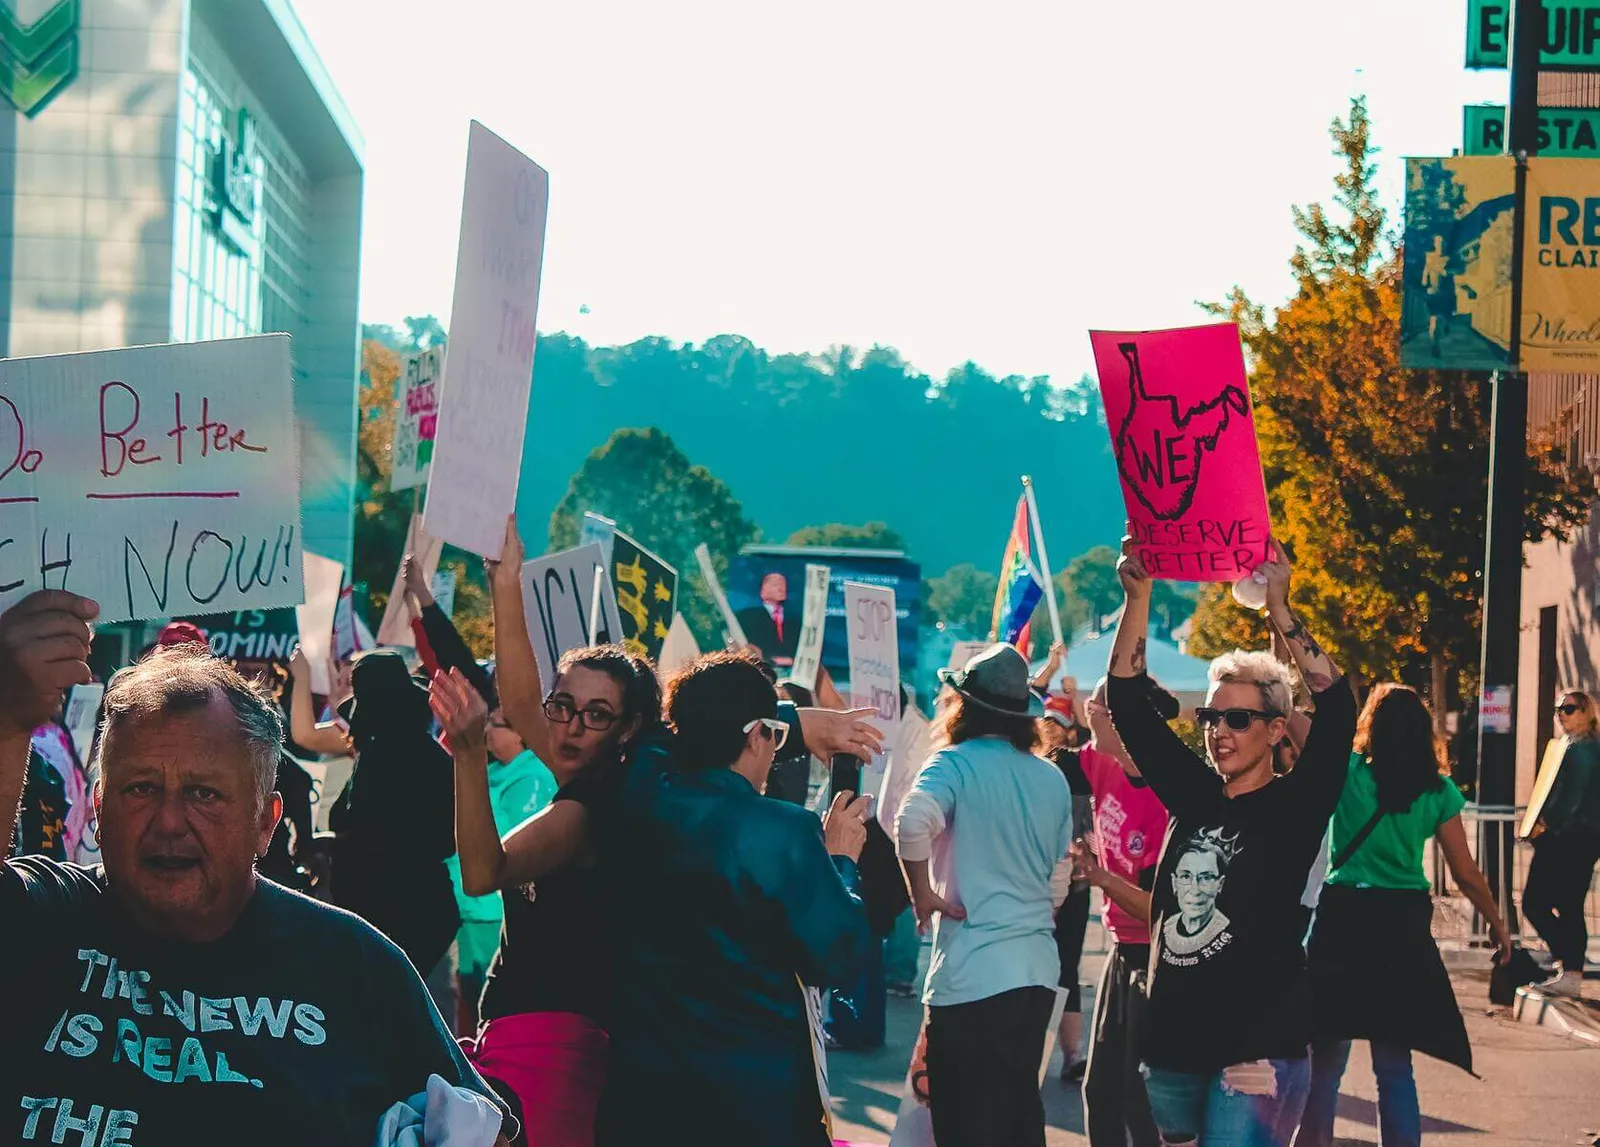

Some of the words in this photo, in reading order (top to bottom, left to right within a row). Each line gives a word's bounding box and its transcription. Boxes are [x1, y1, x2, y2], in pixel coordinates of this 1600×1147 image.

[100, 381, 267, 478] Better
[1129, 430, 1191, 489] WE
[1131, 517, 1262, 546] DESERVE
[44, 1008, 104, 1057] IS
[159, 989, 327, 1046] NEWS
